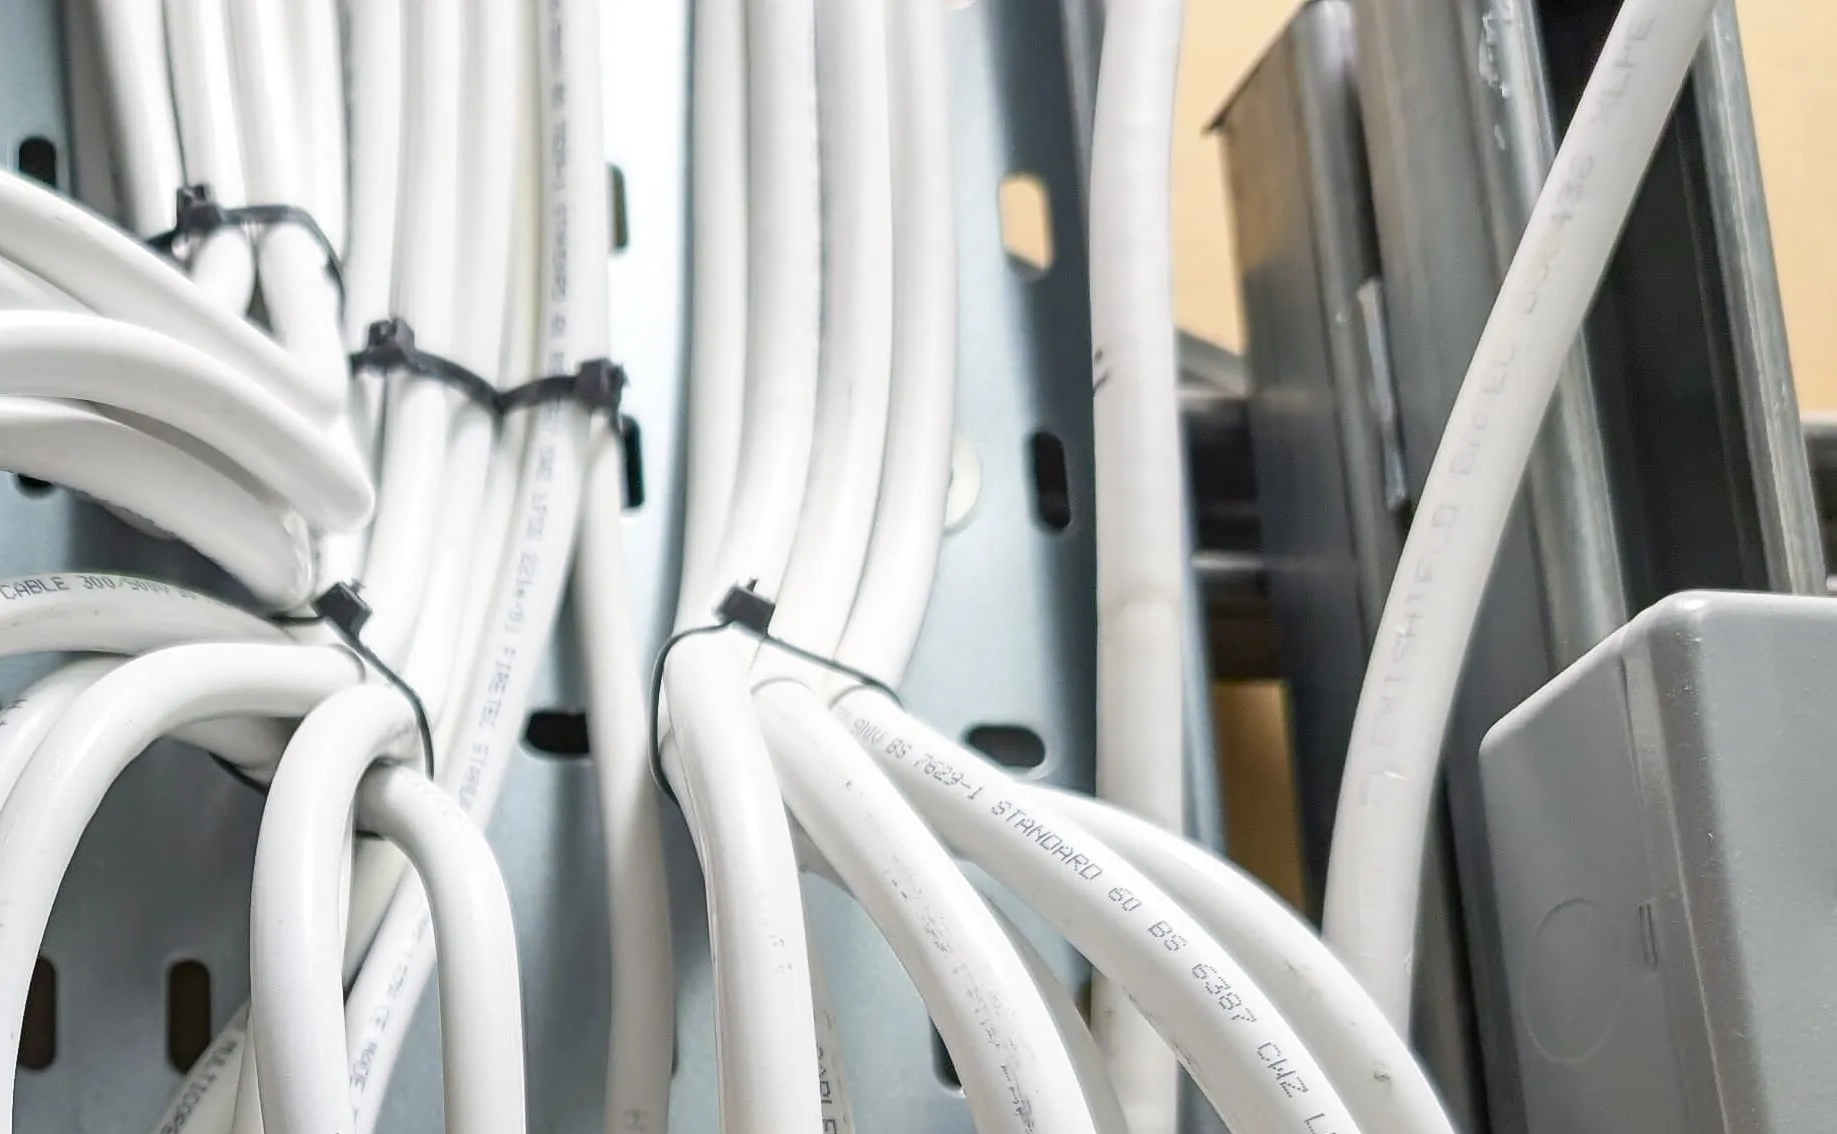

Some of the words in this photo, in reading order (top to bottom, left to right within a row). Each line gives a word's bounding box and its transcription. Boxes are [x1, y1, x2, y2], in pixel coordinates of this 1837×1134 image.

[0, 576, 70, 601] CABLE
[990, 800, 1103, 882] STANDARD
[1146, 918, 1188, 954] BS
[1189, 960, 1258, 1026] 6387
